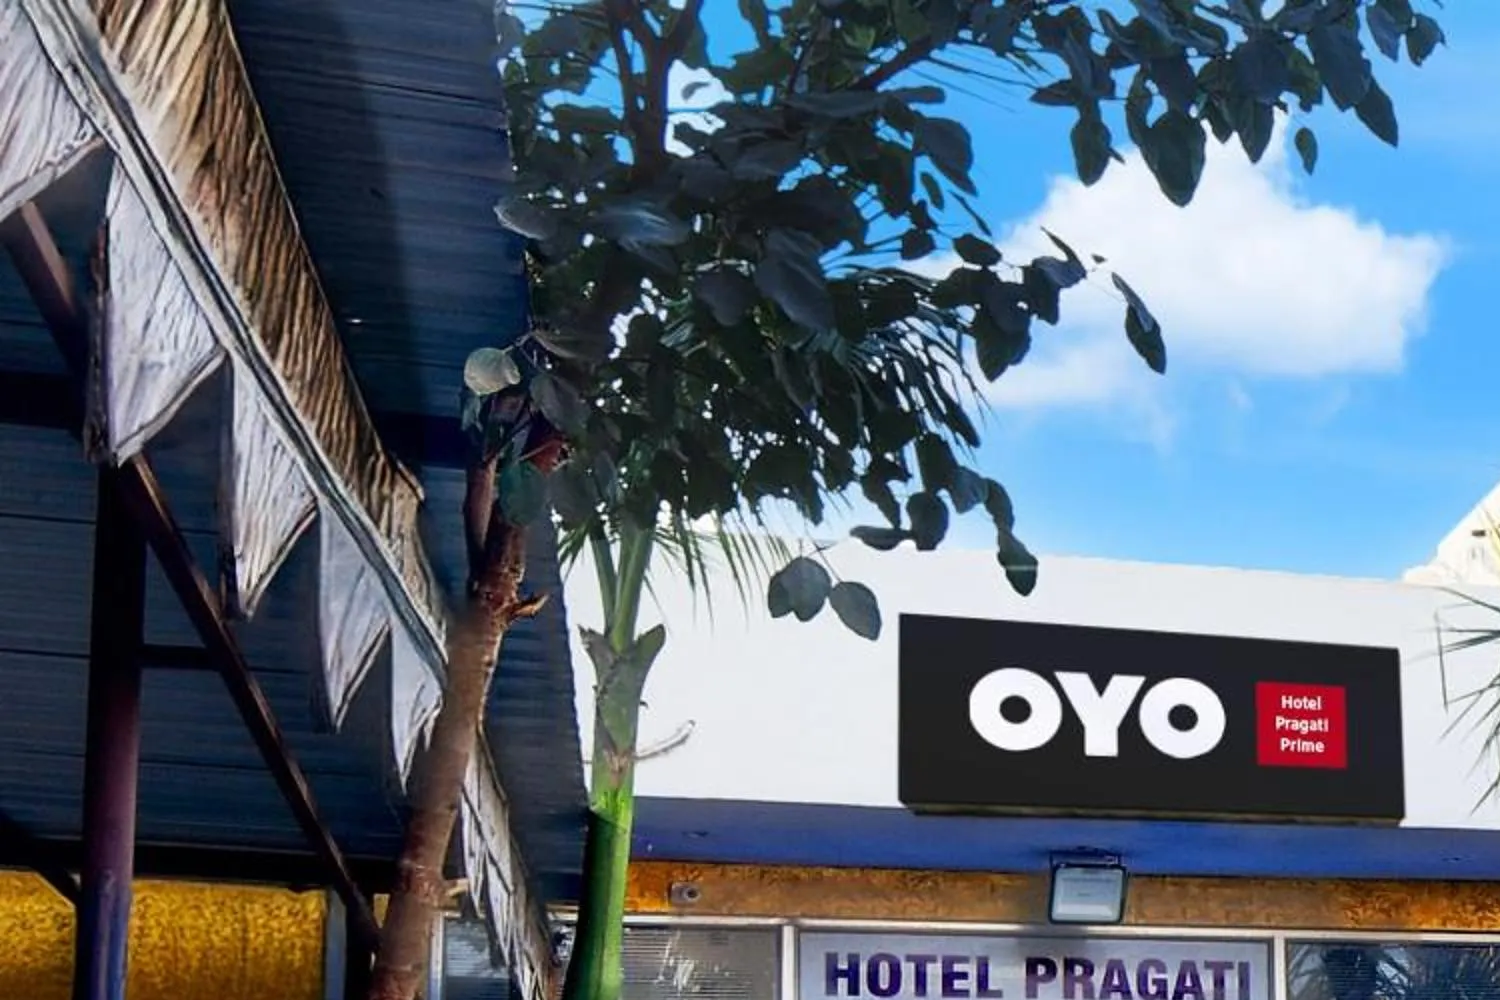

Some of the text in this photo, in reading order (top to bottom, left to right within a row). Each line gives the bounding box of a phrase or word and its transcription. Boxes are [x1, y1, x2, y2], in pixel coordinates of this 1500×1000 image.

[969, 667, 1226, 759] OYO
[1281, 695, 1322, 711] Hotel
[1275, 715, 1329, 735] Pragati
[1281, 737, 1325, 753] Prime
[824, 951, 1003, 999] HOTEL
